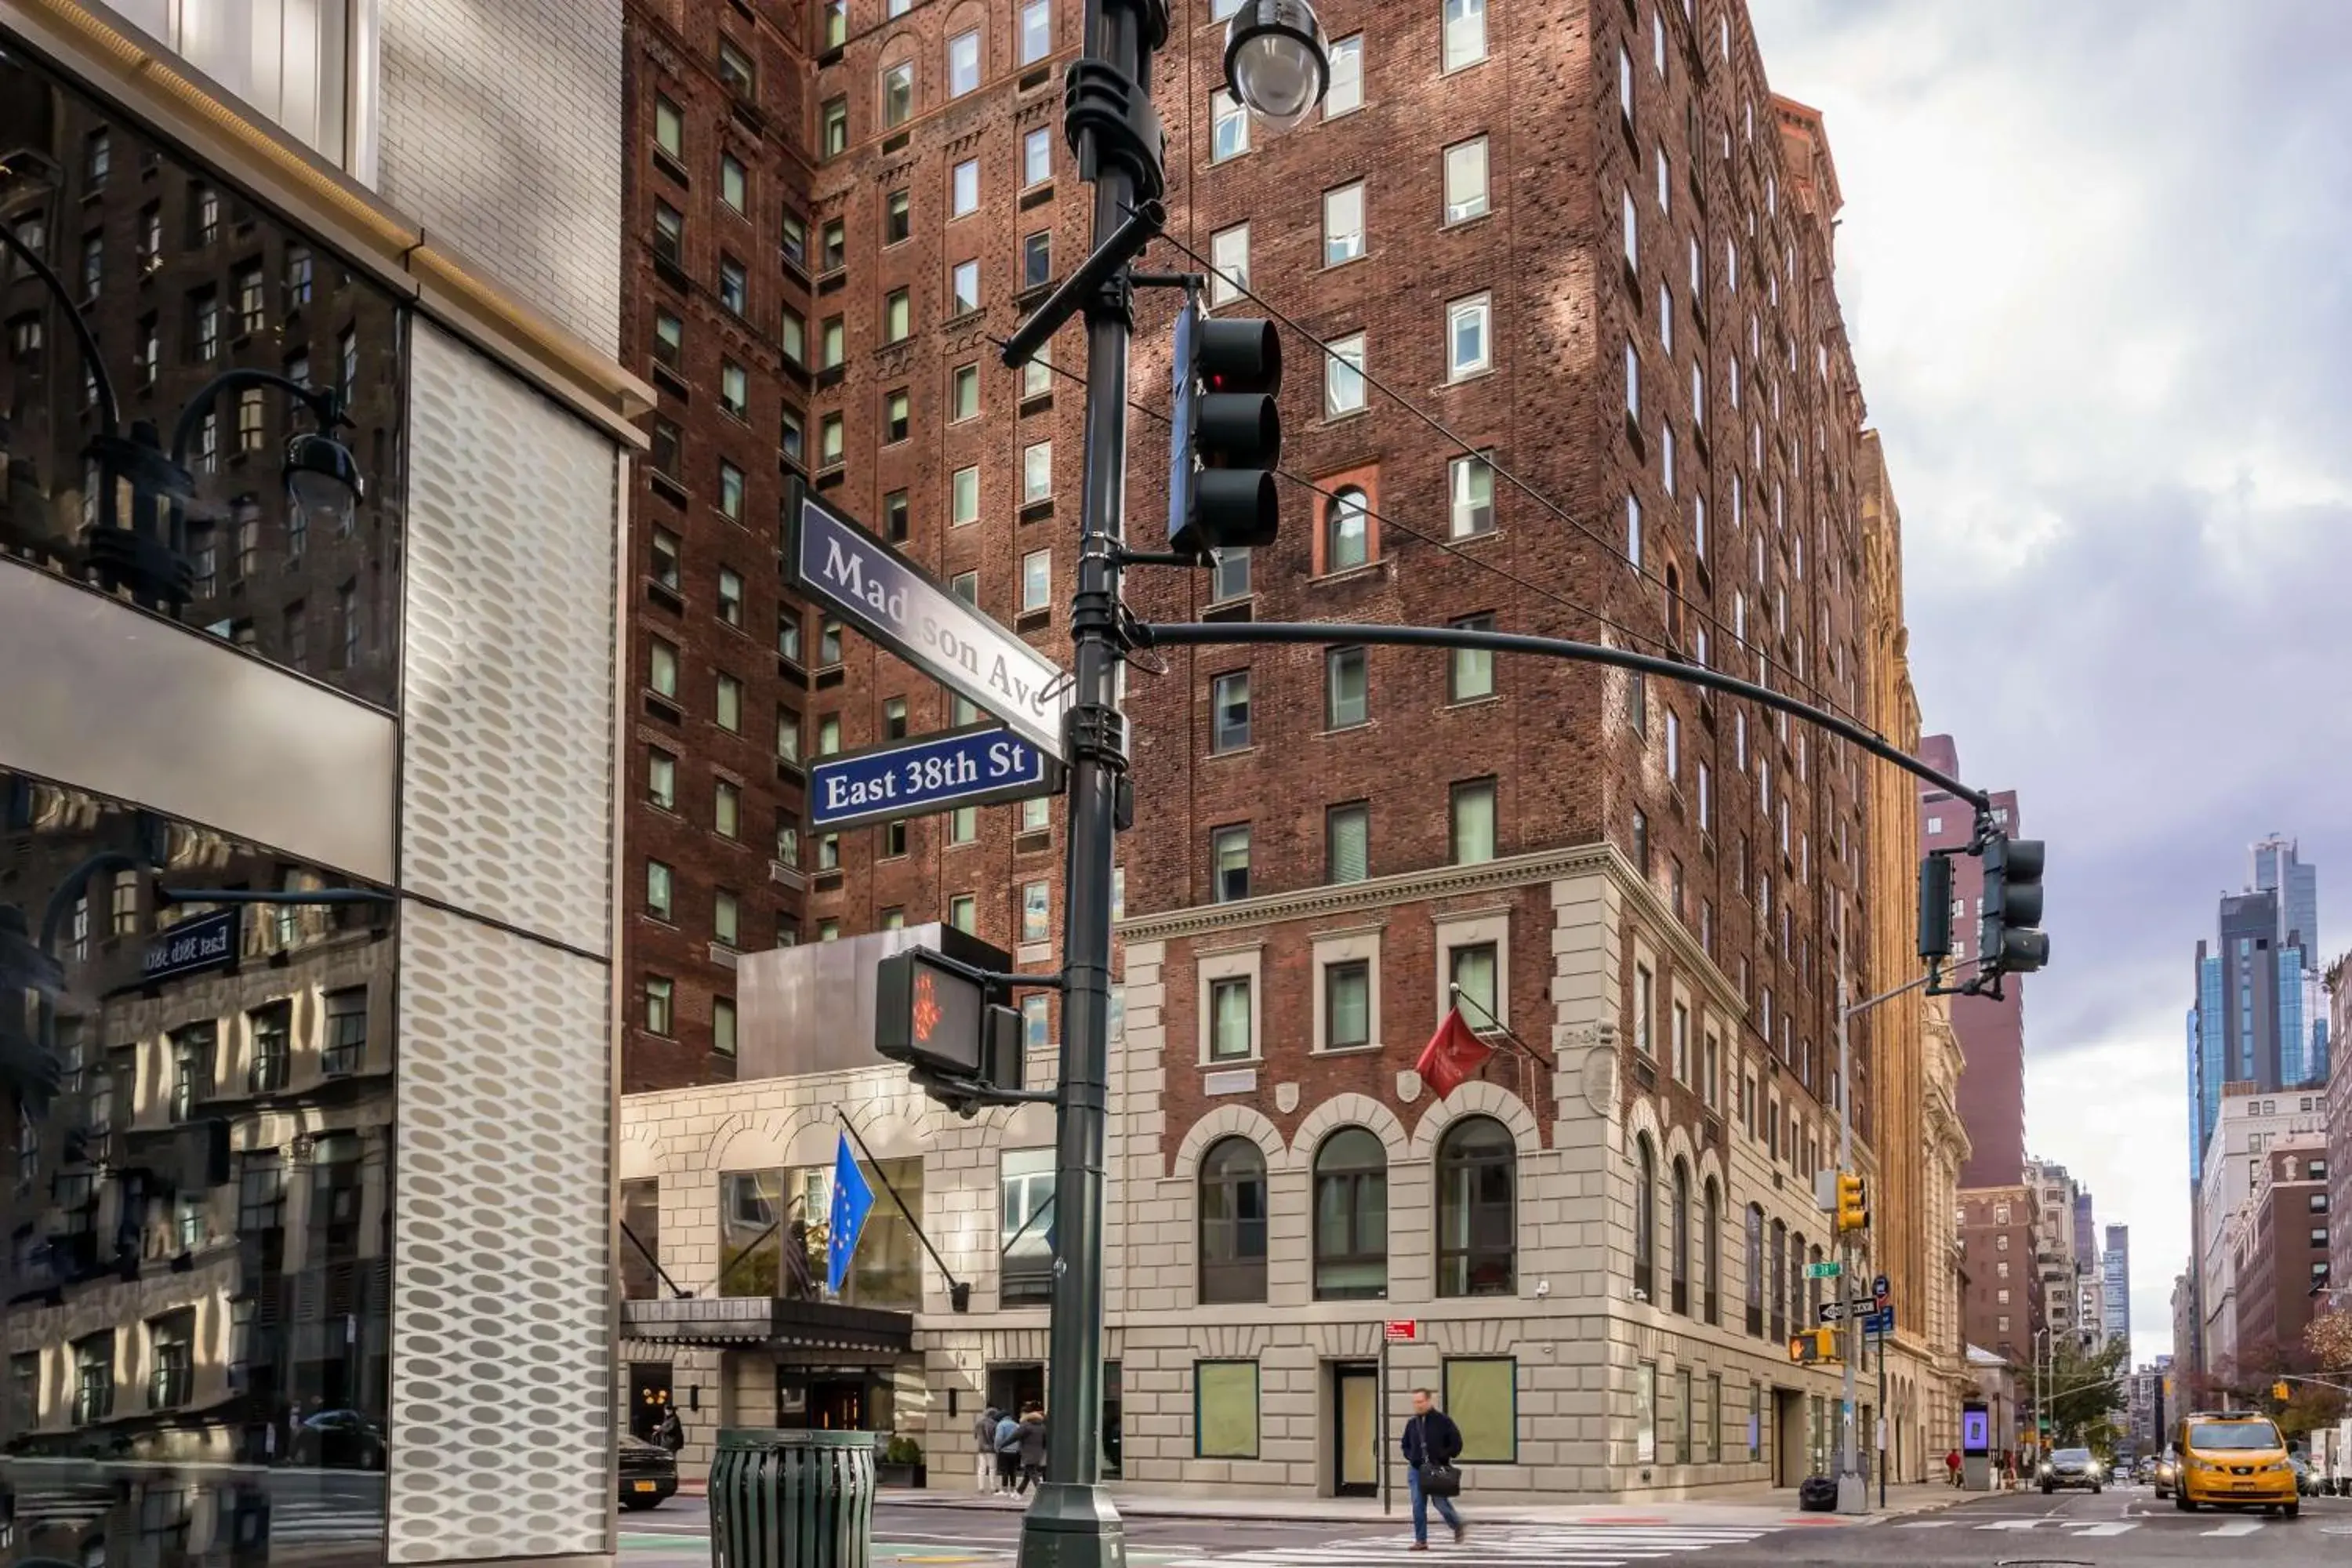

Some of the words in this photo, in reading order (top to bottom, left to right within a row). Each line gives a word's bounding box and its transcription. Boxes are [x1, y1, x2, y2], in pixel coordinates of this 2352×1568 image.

[823, 536, 980, 677] Madson
[989, 654, 1047, 717] Ave
[826, 769, 896, 810] East
[906, 751, 978, 794] 38th
[989, 742, 1025, 777] St
